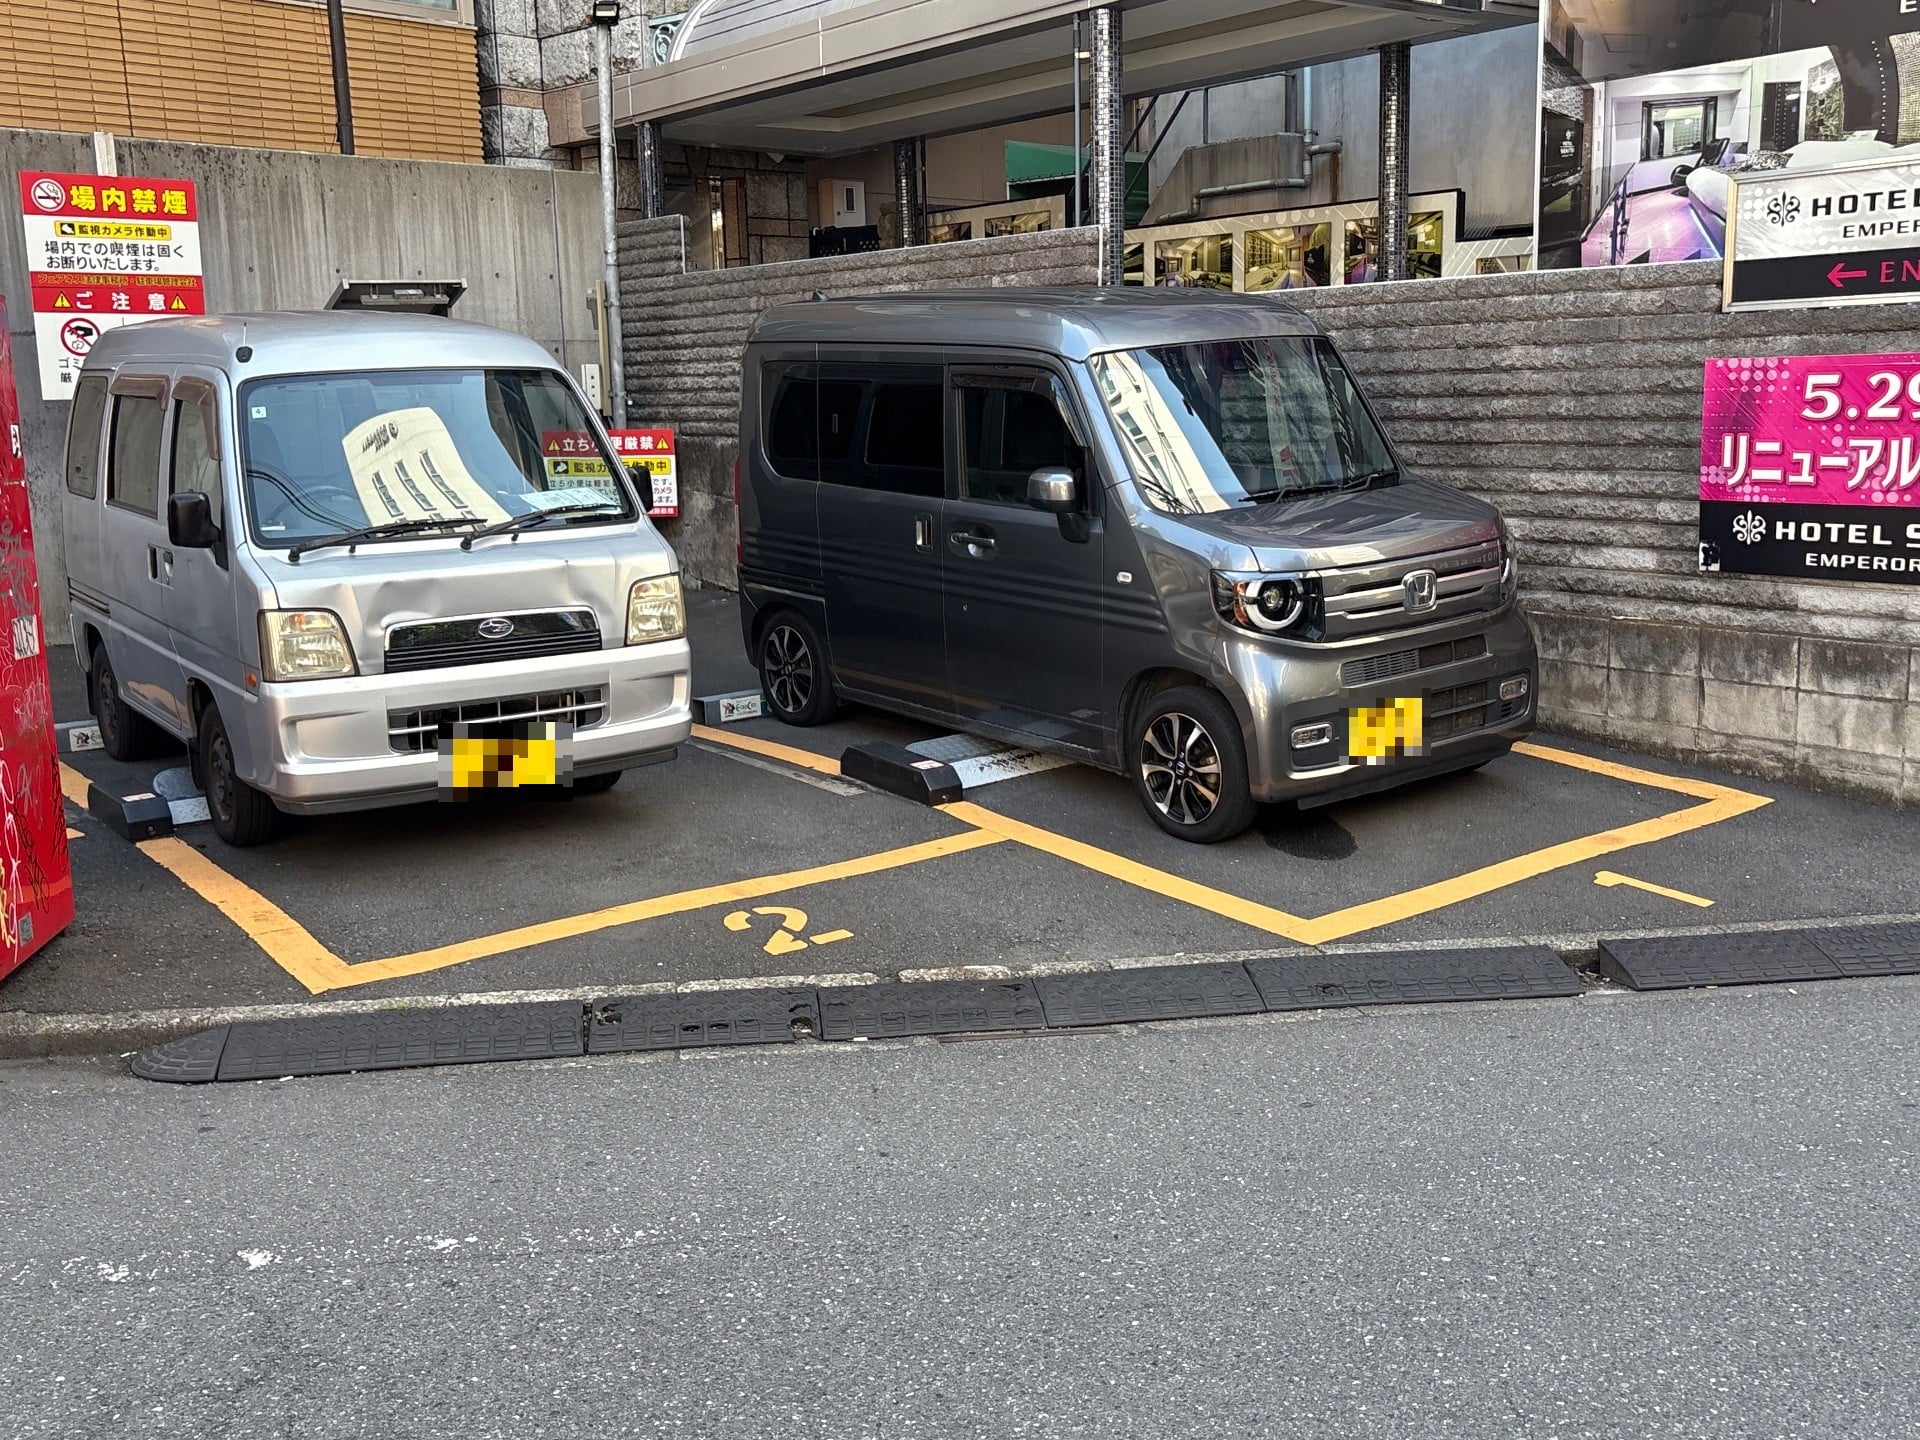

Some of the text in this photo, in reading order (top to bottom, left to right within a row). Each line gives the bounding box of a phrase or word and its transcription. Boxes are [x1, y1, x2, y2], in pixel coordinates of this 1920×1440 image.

[69, 184, 188, 215] 場内禁煙
[78, 224, 167, 238] 監視カメラ作動中
[45, 240, 184, 258] 場内での喫煙は固く
[46, 255, 160, 272] お断りいたします。
[76, 290, 166, 311] ご注意
[1775, 520, 1893, 546] HOTEL
[724, 906, 855, 956] 2
